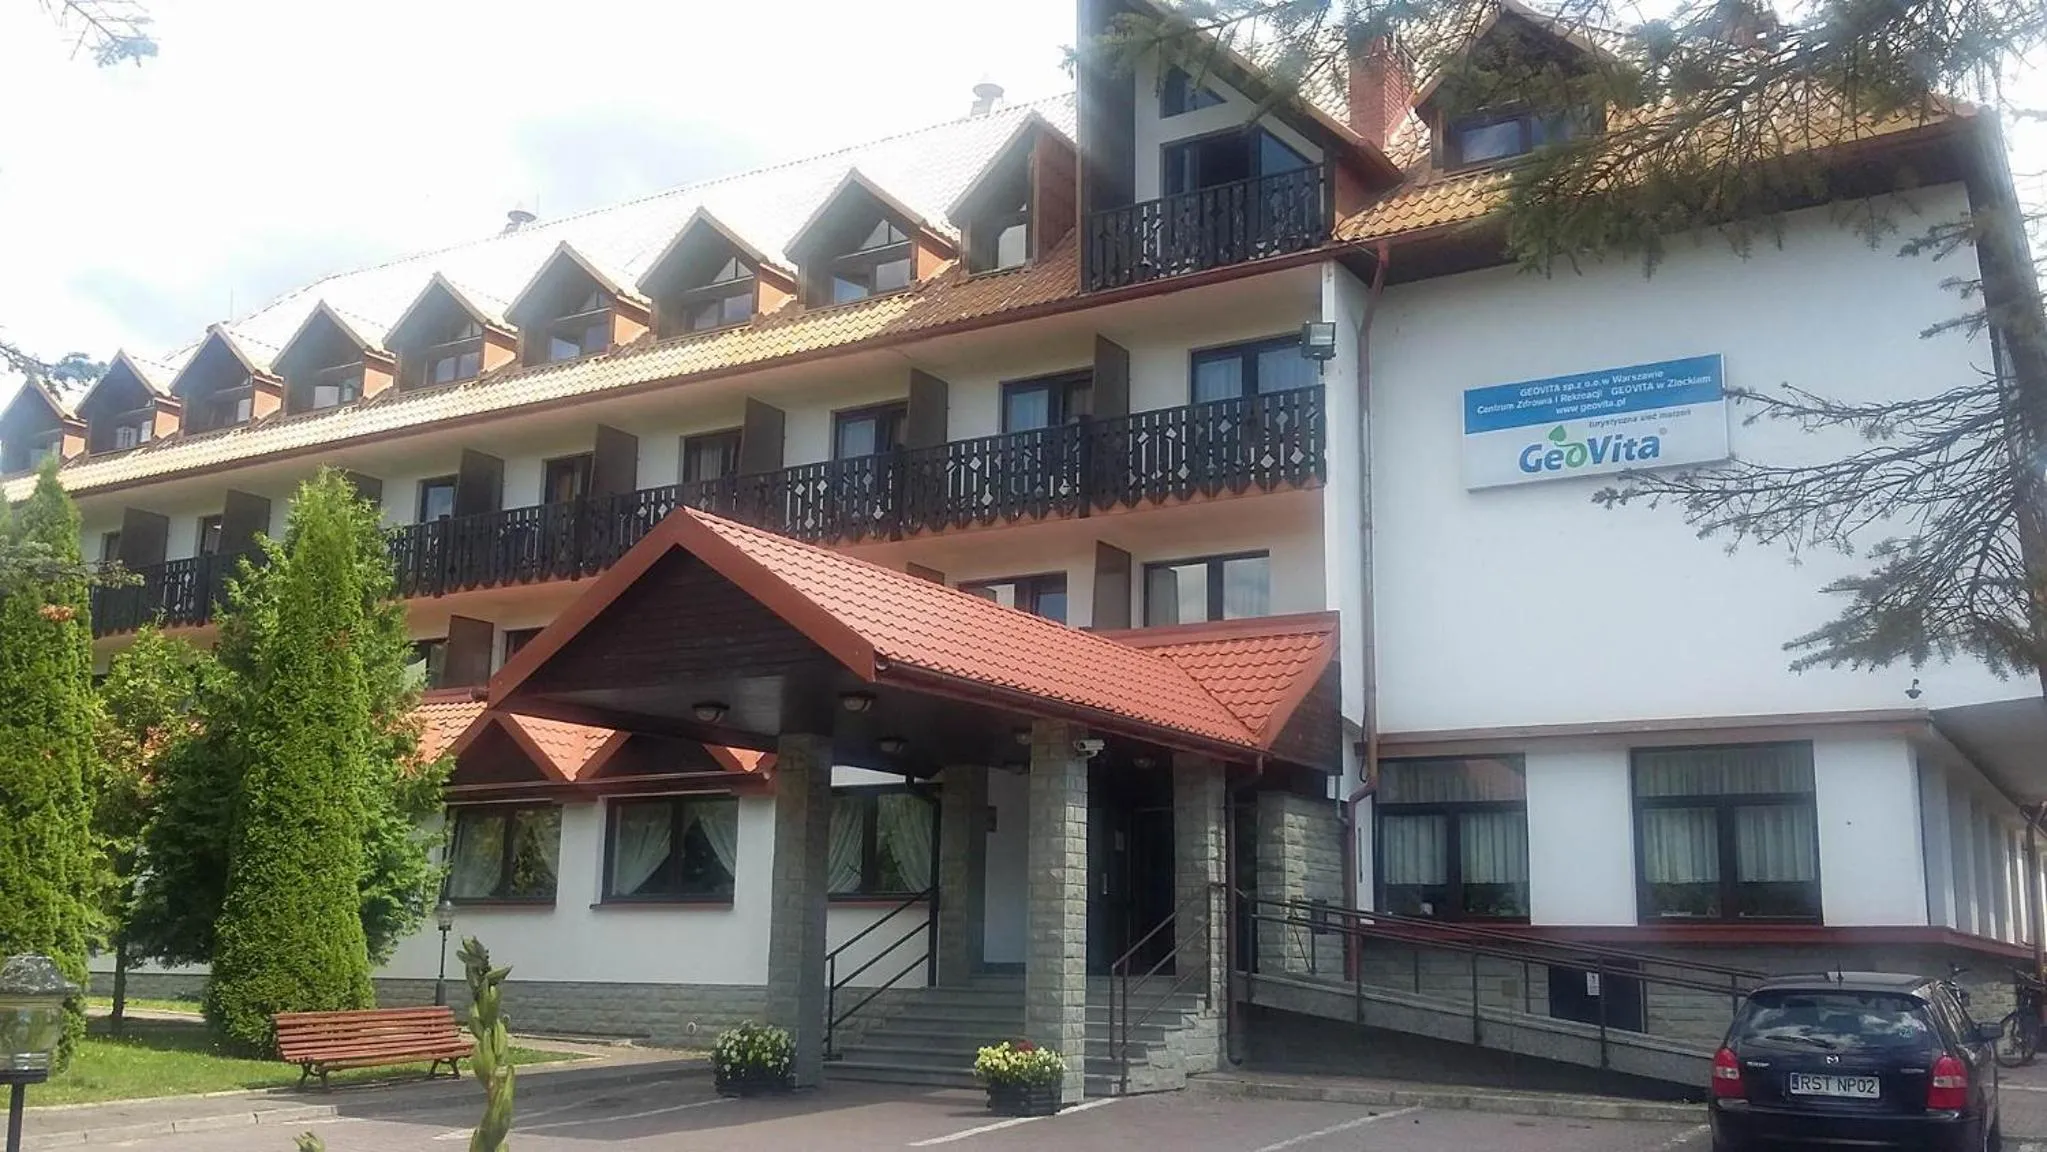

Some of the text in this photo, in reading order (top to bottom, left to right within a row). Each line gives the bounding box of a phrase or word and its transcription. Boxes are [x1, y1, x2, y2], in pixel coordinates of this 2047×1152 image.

[1520, 384, 1560, 397] GEOVITA
[1602, 379, 1610, 387] w
[1612, 371, 1664, 384] Warszawie
[1477, 402, 1514, 414] Centrum
[1516, 398, 1553, 409] Zdrowia
[1560, 390, 1603, 403] Rekreacji
[1611, 383, 1654, 396] GEOVITA
[1556, 397, 1626, 414] www.geovita.pl
[1519, 434, 1660, 473] GeoVita
[1800, 1076, 1876, 1094] RST NP02
